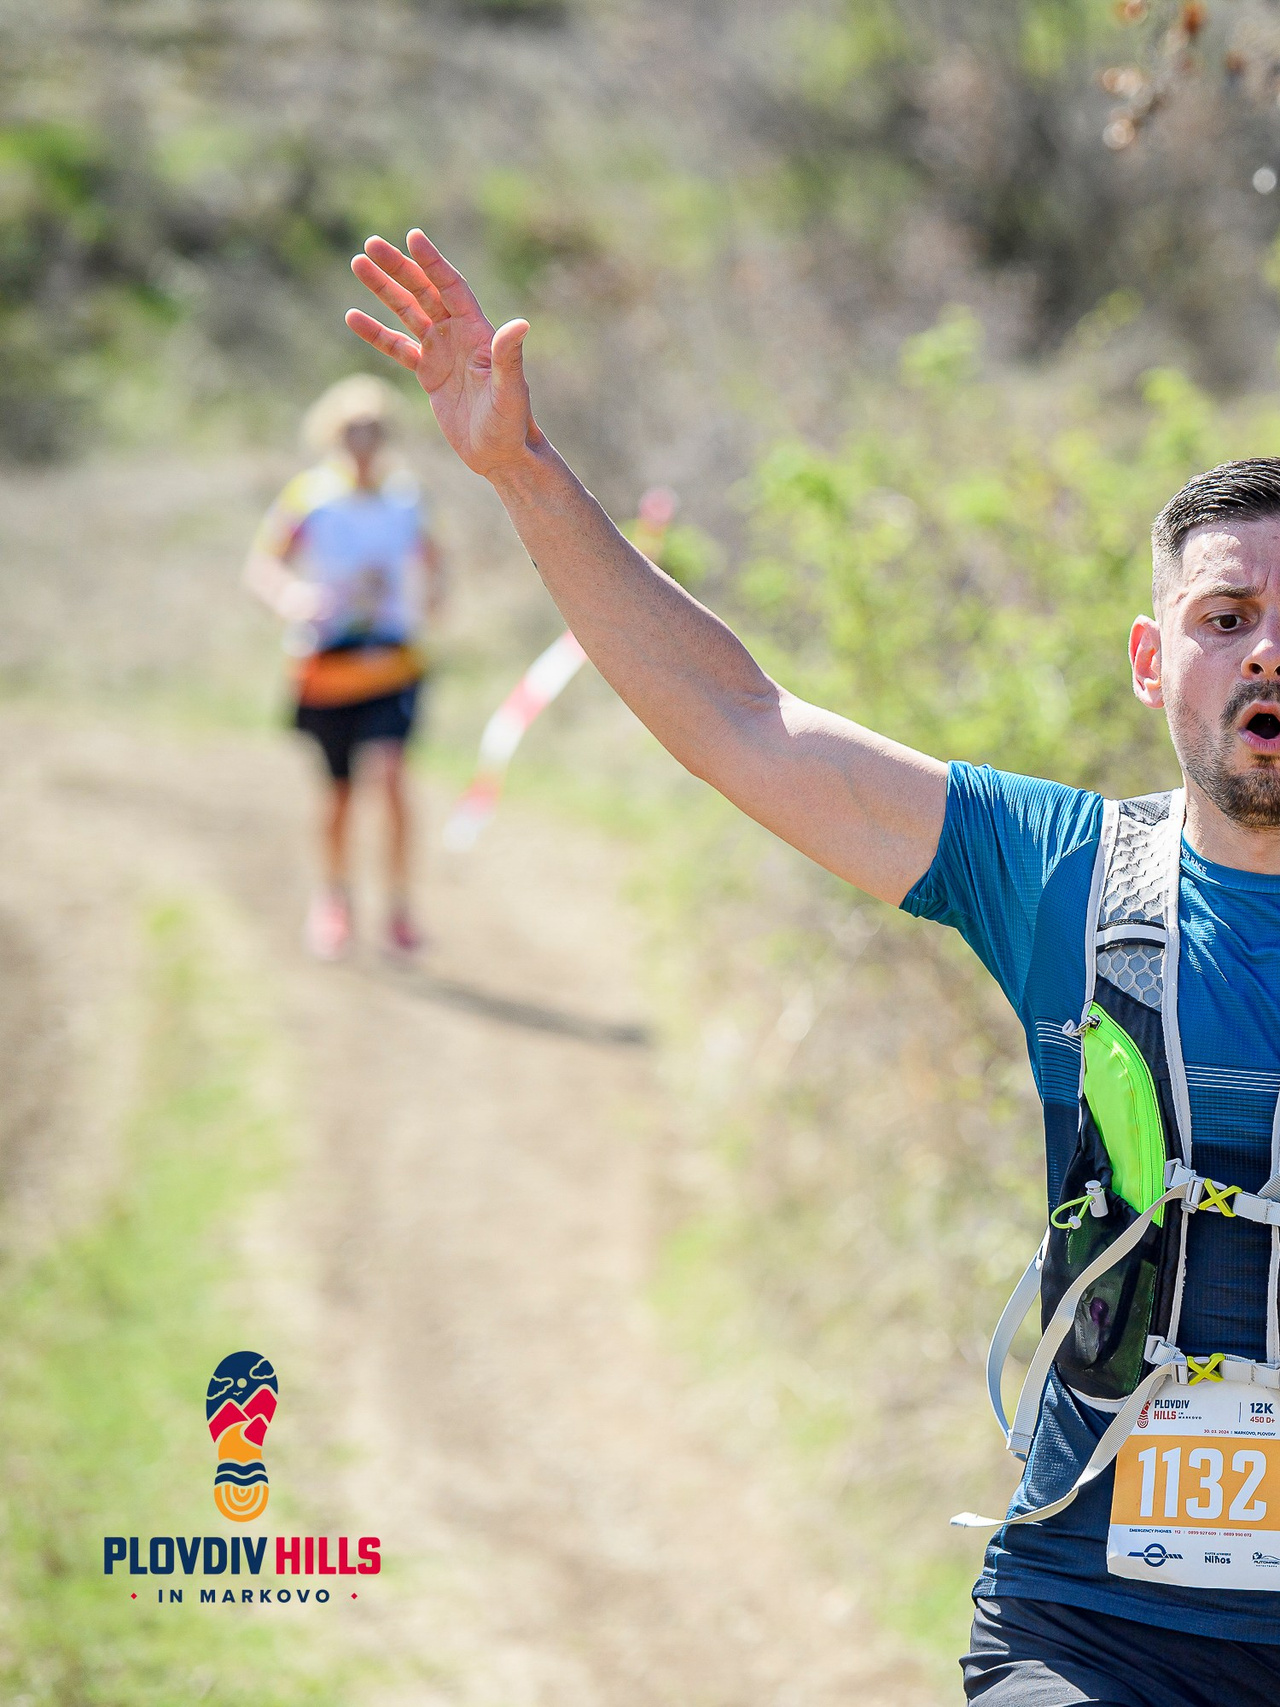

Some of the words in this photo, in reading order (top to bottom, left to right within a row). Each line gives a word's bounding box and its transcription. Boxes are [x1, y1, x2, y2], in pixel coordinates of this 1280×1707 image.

[1154, 1399, 1190, 1409] PLOVDIV
[1250, 1402, 1274, 1414] 12K
[1153, 1410, 1177, 1420] HILLS
[1138, 1447, 1268, 1522] 1132
